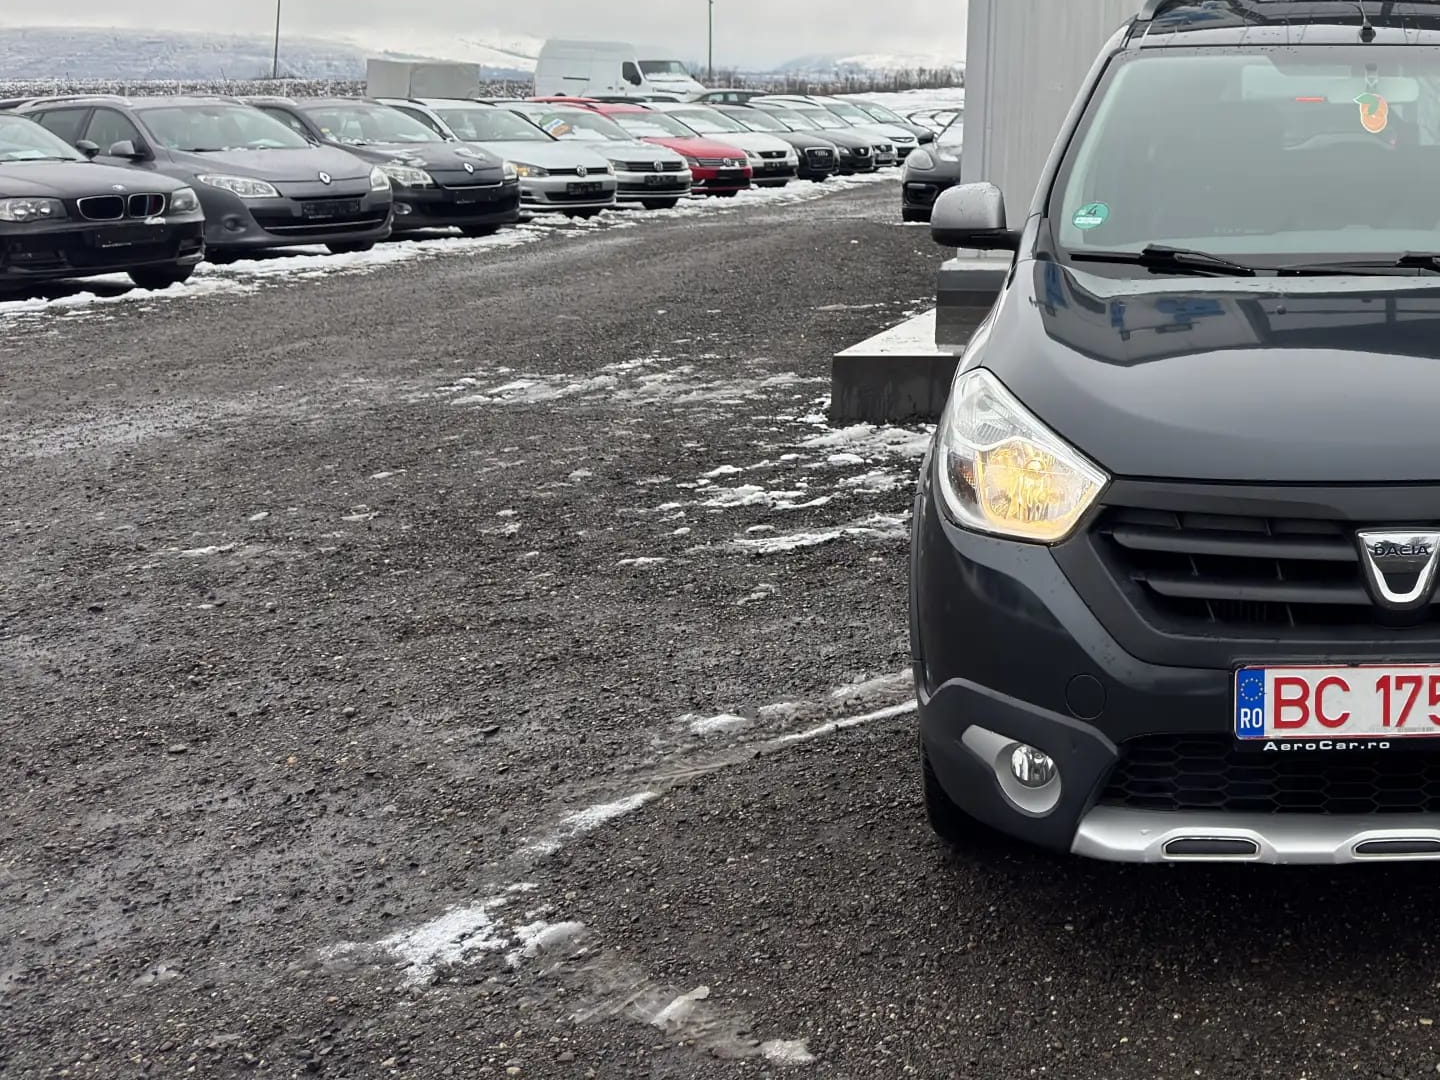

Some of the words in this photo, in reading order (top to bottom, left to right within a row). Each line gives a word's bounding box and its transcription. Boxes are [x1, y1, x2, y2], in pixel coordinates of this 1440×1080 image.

[1374, 544, 1430, 556] DACIA
[1272, 676, 1350, 730] BC
[1240, 708, 1263, 729] RO
[1263, 740, 1390, 751] AeroCar.ro
